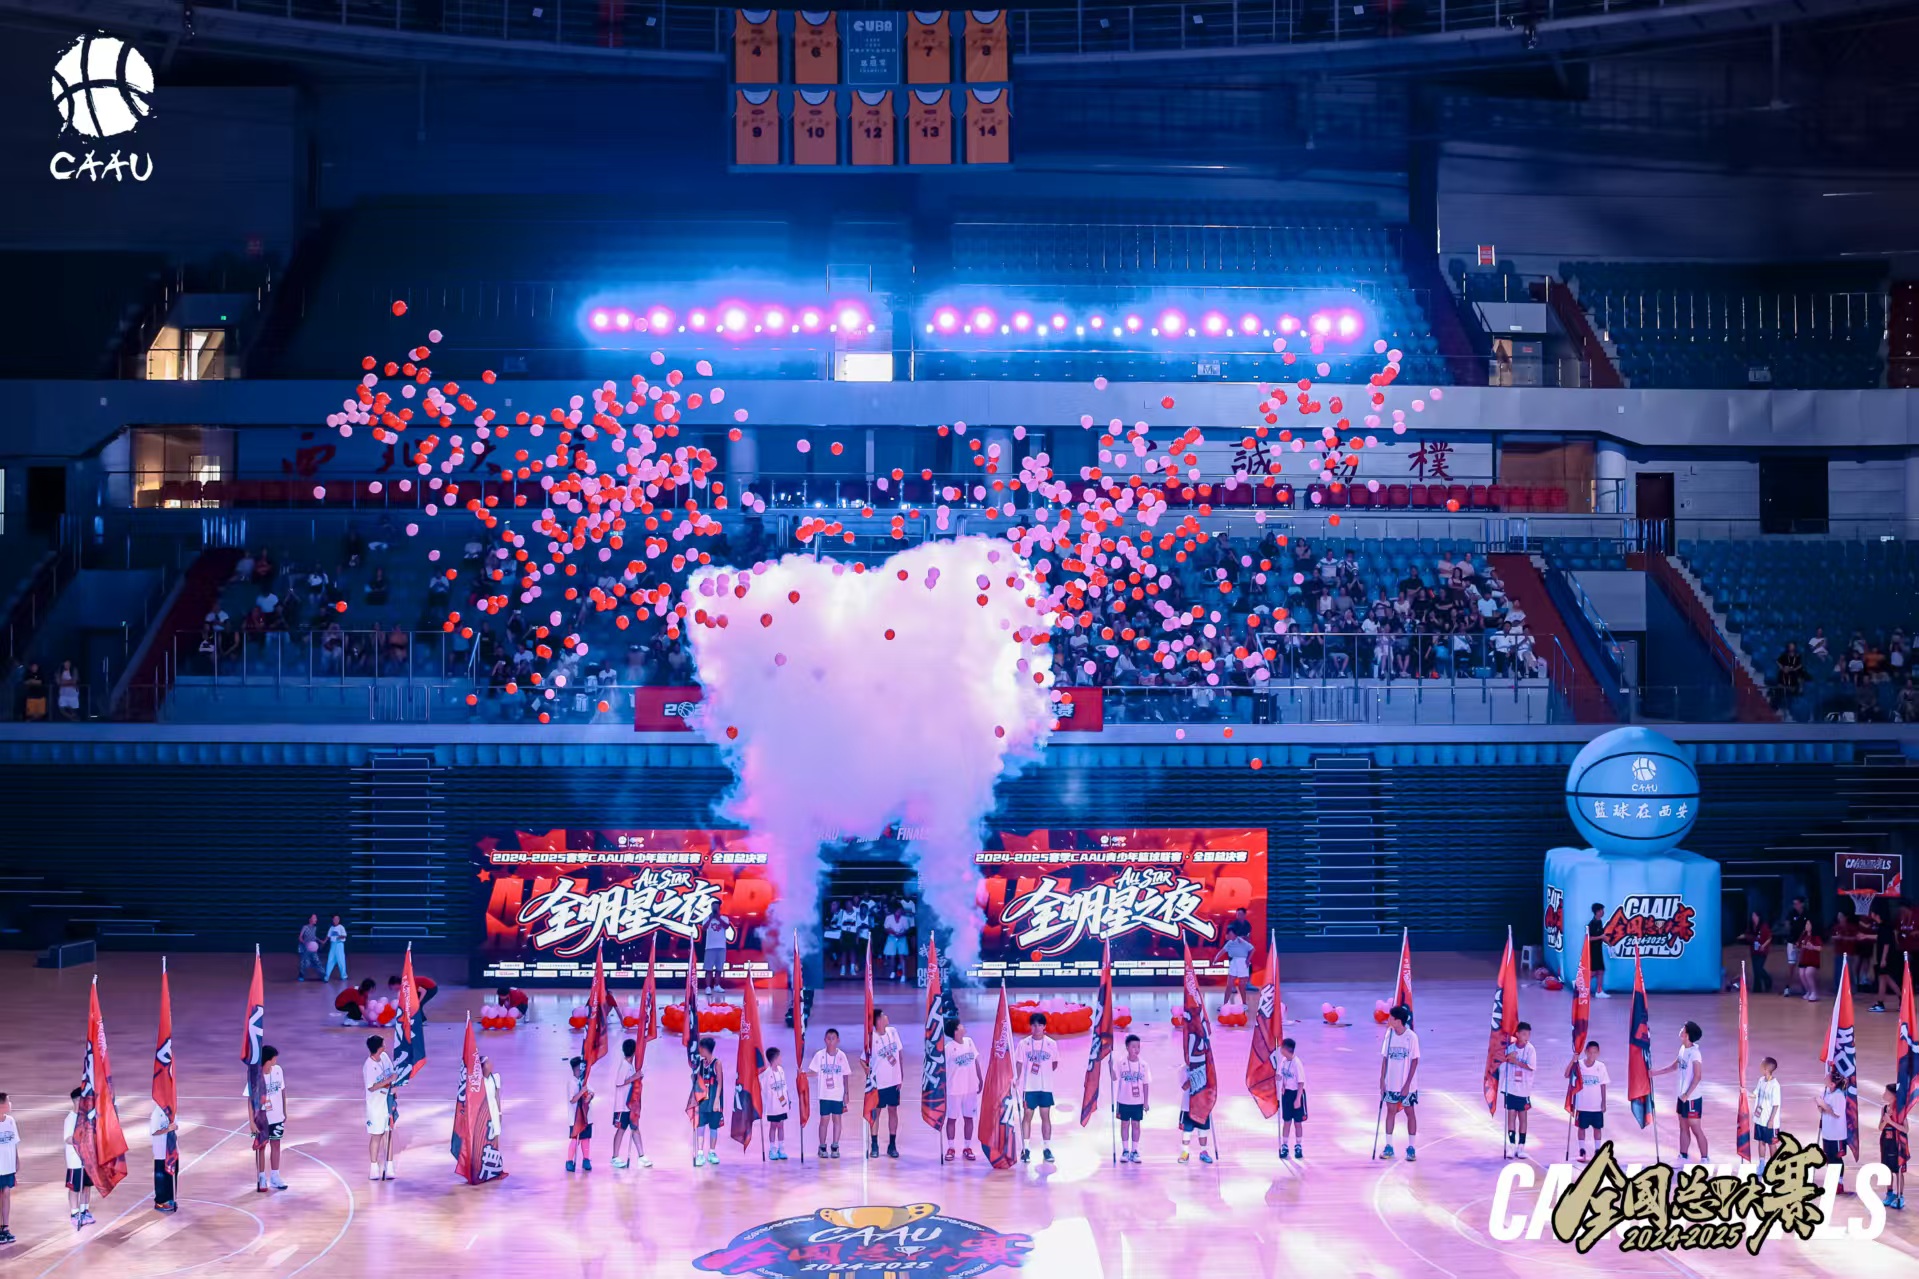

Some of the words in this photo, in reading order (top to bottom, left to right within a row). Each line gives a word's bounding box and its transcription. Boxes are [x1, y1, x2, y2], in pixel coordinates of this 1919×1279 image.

[854, 21, 893, 32] CUBA
[752, 46, 762, 57] 4
[924, 46, 933, 57] 7
[752, 127, 762, 138] 9
[806, 127, 825, 138] 10
[864, 127, 882, 139] 12
[922, 126, 939, 138] 13
[978, 125, 997, 137] 14
[1631, 783, 1658, 792] CAAU
[1594, 800, 1689, 819] 篮球在西安
[659, 869, 692, 890] STAR
[1140, 867, 1174, 887] STAR
[518, 877, 736, 955] 全明星之夜
[1002, 876, 1217, 954] 全明星之夜
[808, 1226, 943, 1246] CAAU
[800, 1261, 934, 1272] 2024-2025
